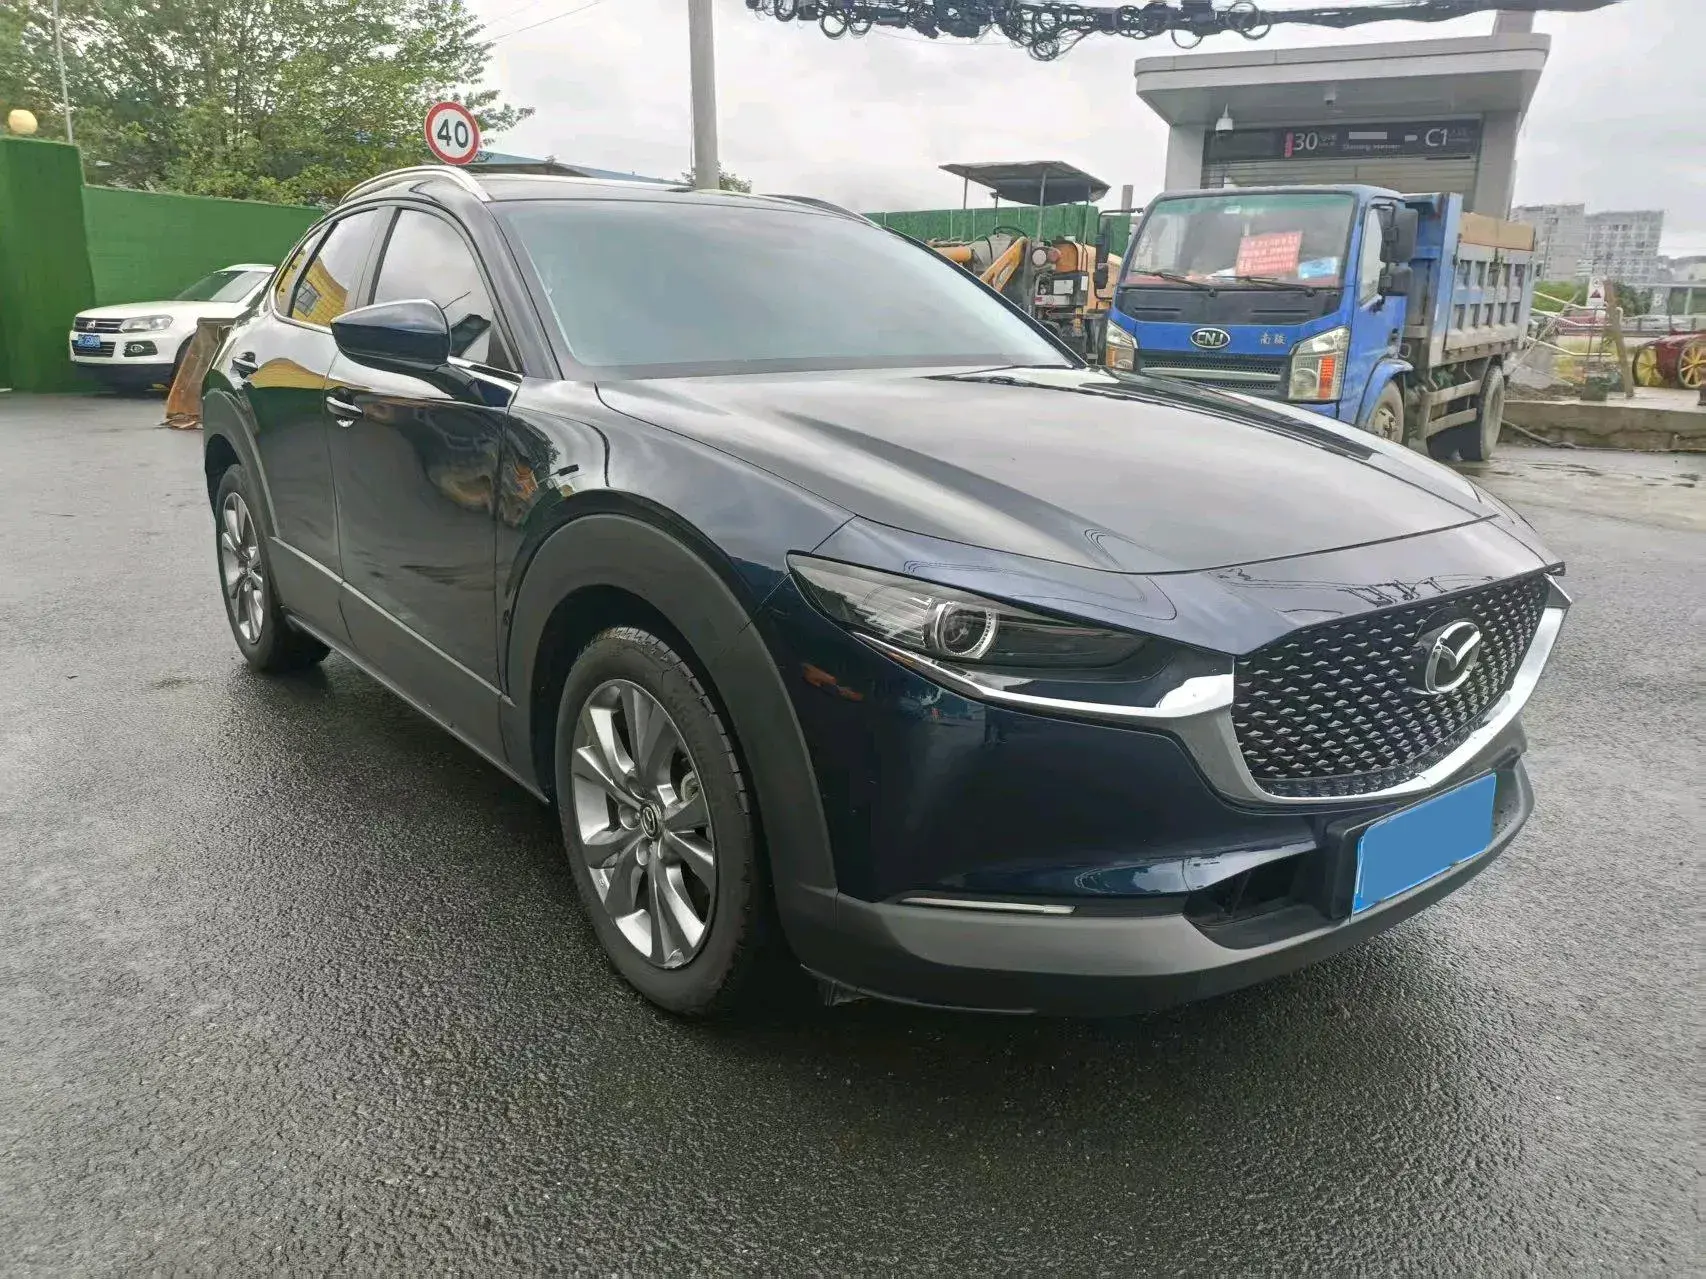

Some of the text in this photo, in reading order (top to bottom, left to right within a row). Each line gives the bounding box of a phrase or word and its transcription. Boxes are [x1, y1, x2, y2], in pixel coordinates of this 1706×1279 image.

[437, 119, 469, 148] 40
[1293, 131, 1318, 151] 30
[1425, 128, 1448, 147] C1
[1196, 331, 1224, 346] CNJ
